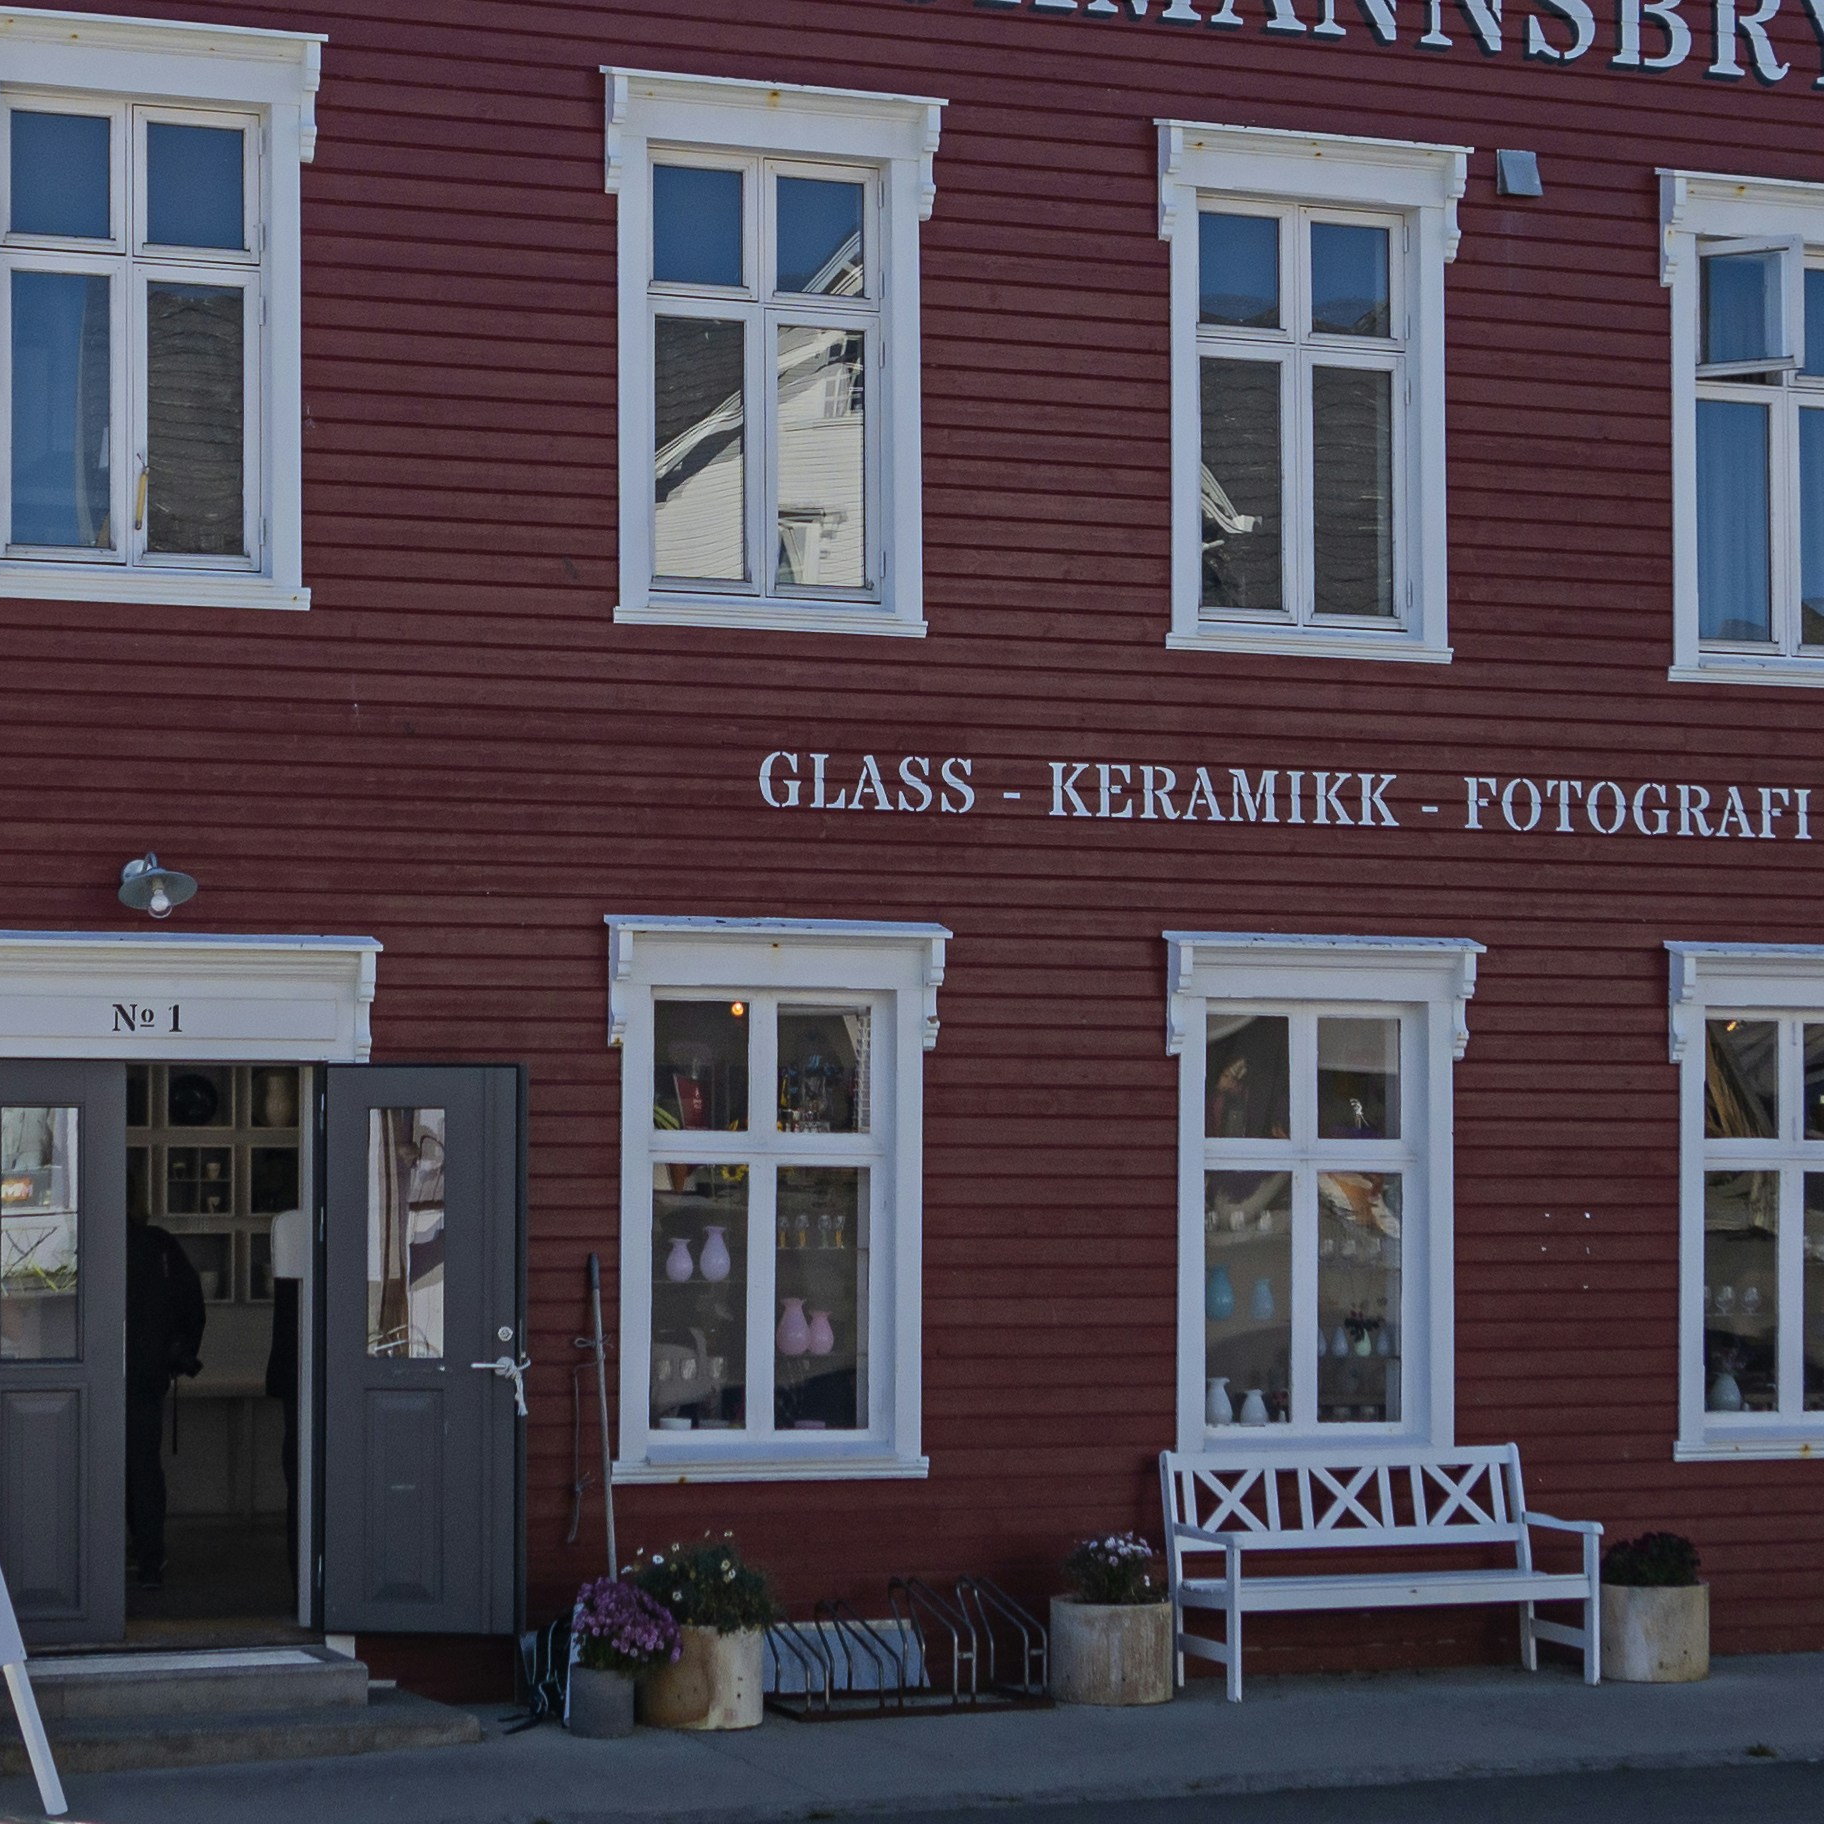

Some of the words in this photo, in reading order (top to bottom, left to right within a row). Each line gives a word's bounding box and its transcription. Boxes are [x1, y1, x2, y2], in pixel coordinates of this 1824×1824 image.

[758, 751, 975, 814] GLASS
[1048, 761, 1400, 827] KERAMIKK
[1463, 776, 1813, 840] FOTOGRAFI
[168, 1004, 183, 1033] 1
